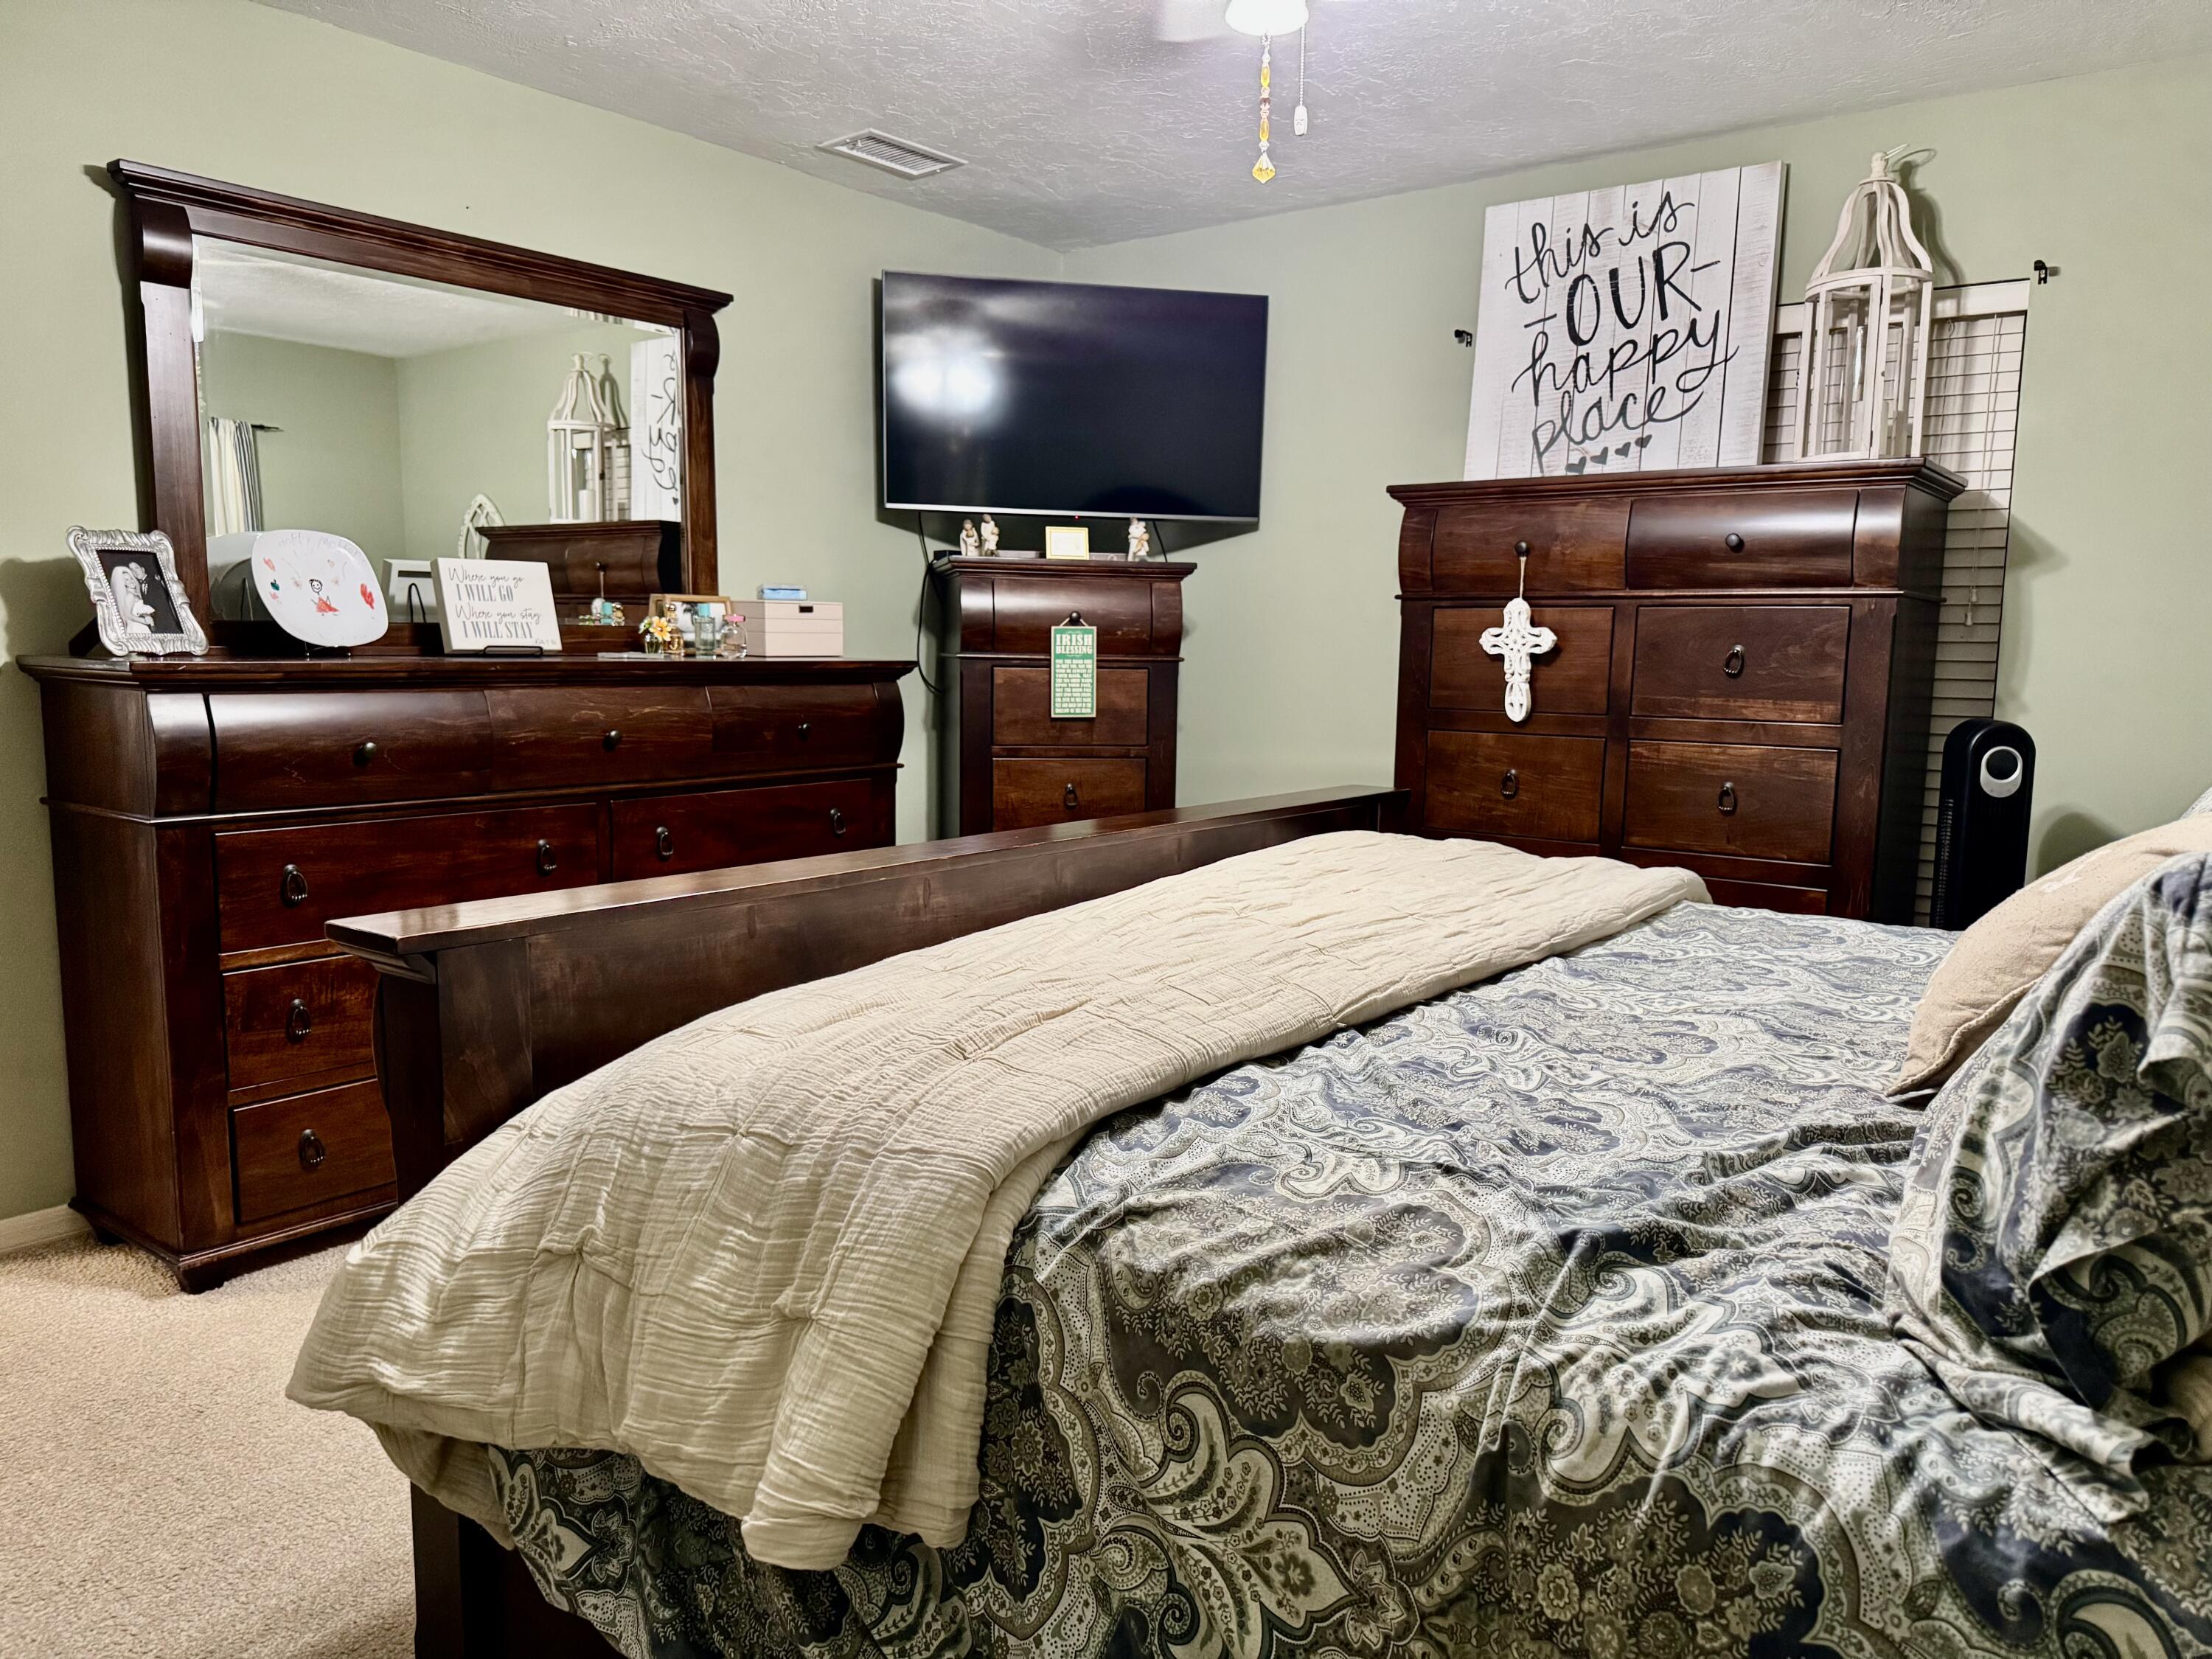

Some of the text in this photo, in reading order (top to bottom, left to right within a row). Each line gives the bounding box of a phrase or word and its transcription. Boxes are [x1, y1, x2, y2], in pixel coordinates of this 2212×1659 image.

[1505, 190, 1695, 305] this is
[1512, 309, 1740, 407] happy
[1531, 386, 1704, 476] place
[448, 564, 524, 588] Where you go
[456, 583, 514, 602] I WILL GO
[455, 602, 541, 625] Where you stay
[462, 621, 533, 639] I WILL STAY
[1056, 634, 1093, 646] IRISH
[1056, 645, 1092, 654] BLESSING
